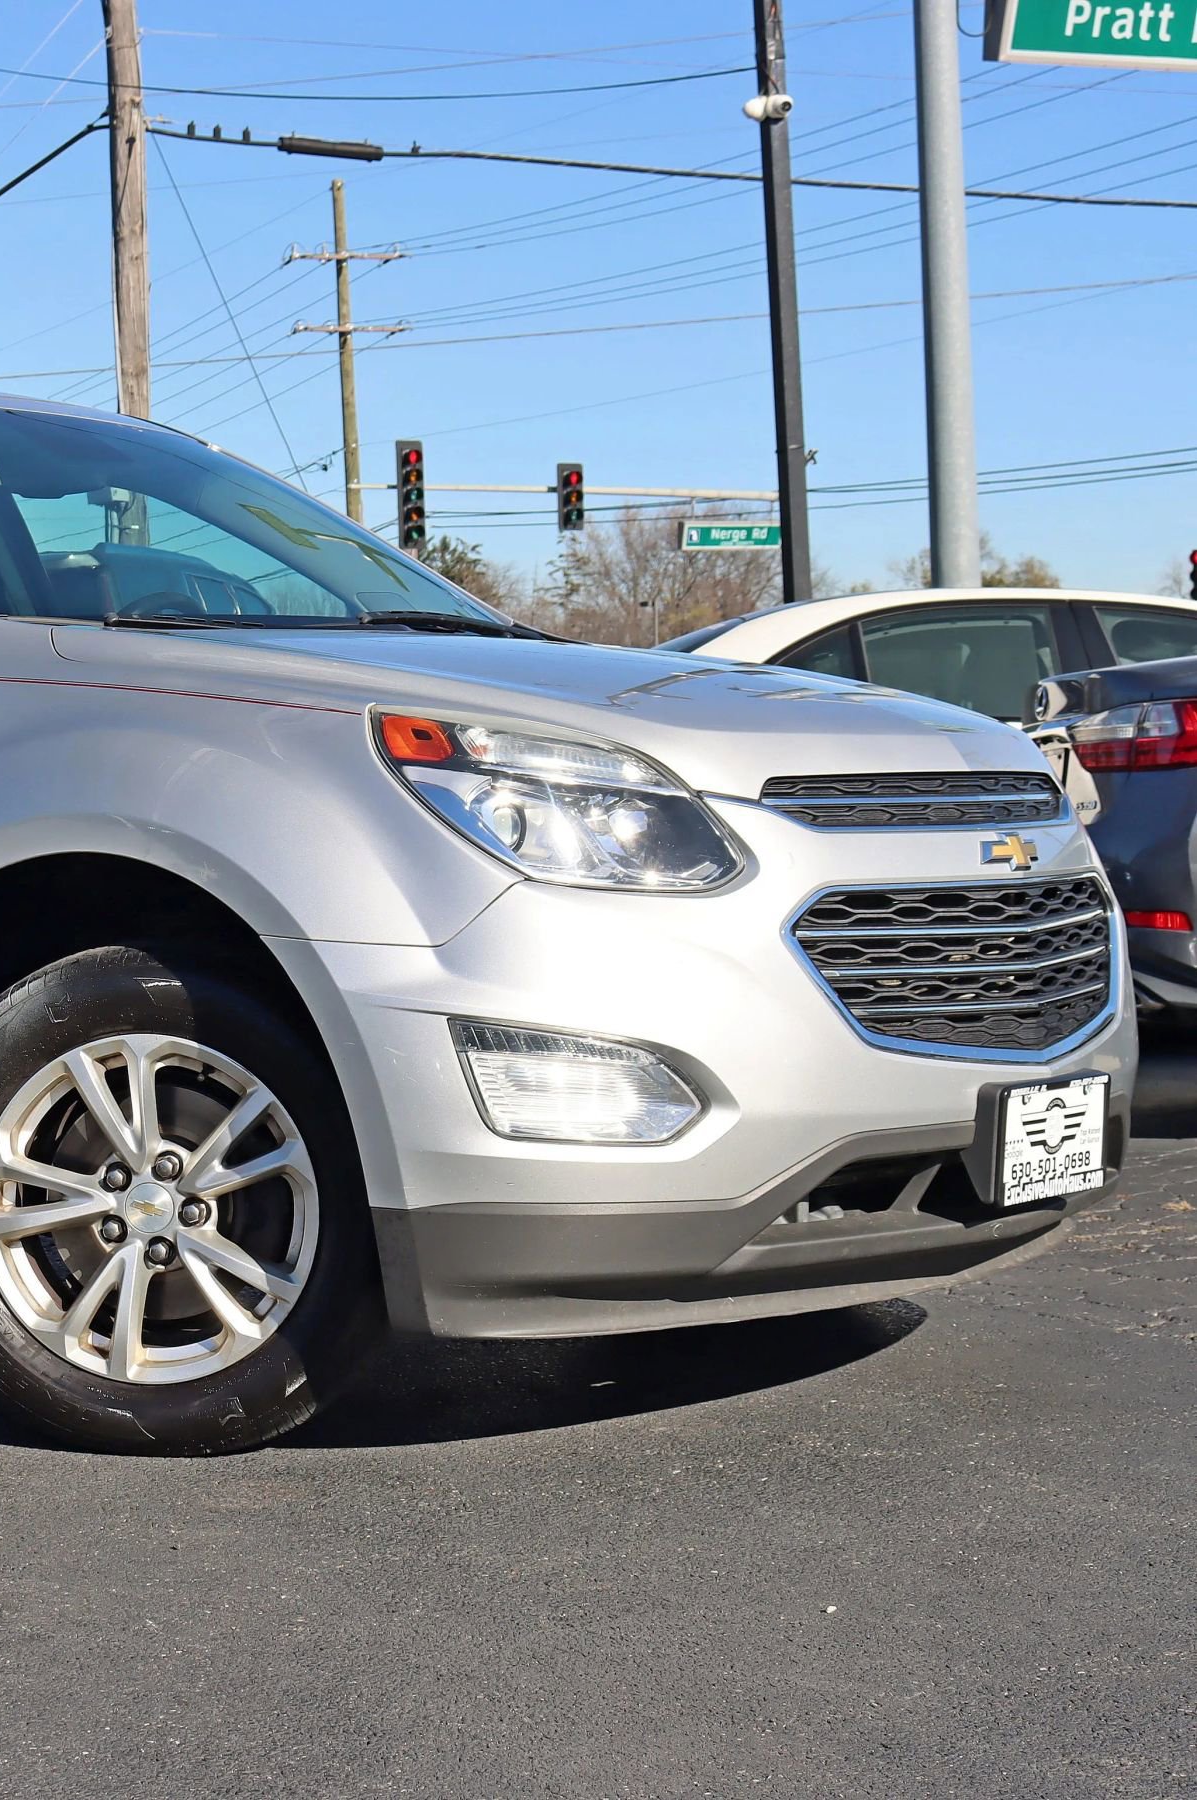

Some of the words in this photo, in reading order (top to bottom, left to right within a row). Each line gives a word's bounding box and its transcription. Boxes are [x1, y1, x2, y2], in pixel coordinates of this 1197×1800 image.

[1064, 0, 1175, 42] Pratt
[710, 528, 748, 541] Nerge
[751, 527, 769, 540] Rd
[1011, 1151, 1091, 1180] 630-501-0698
